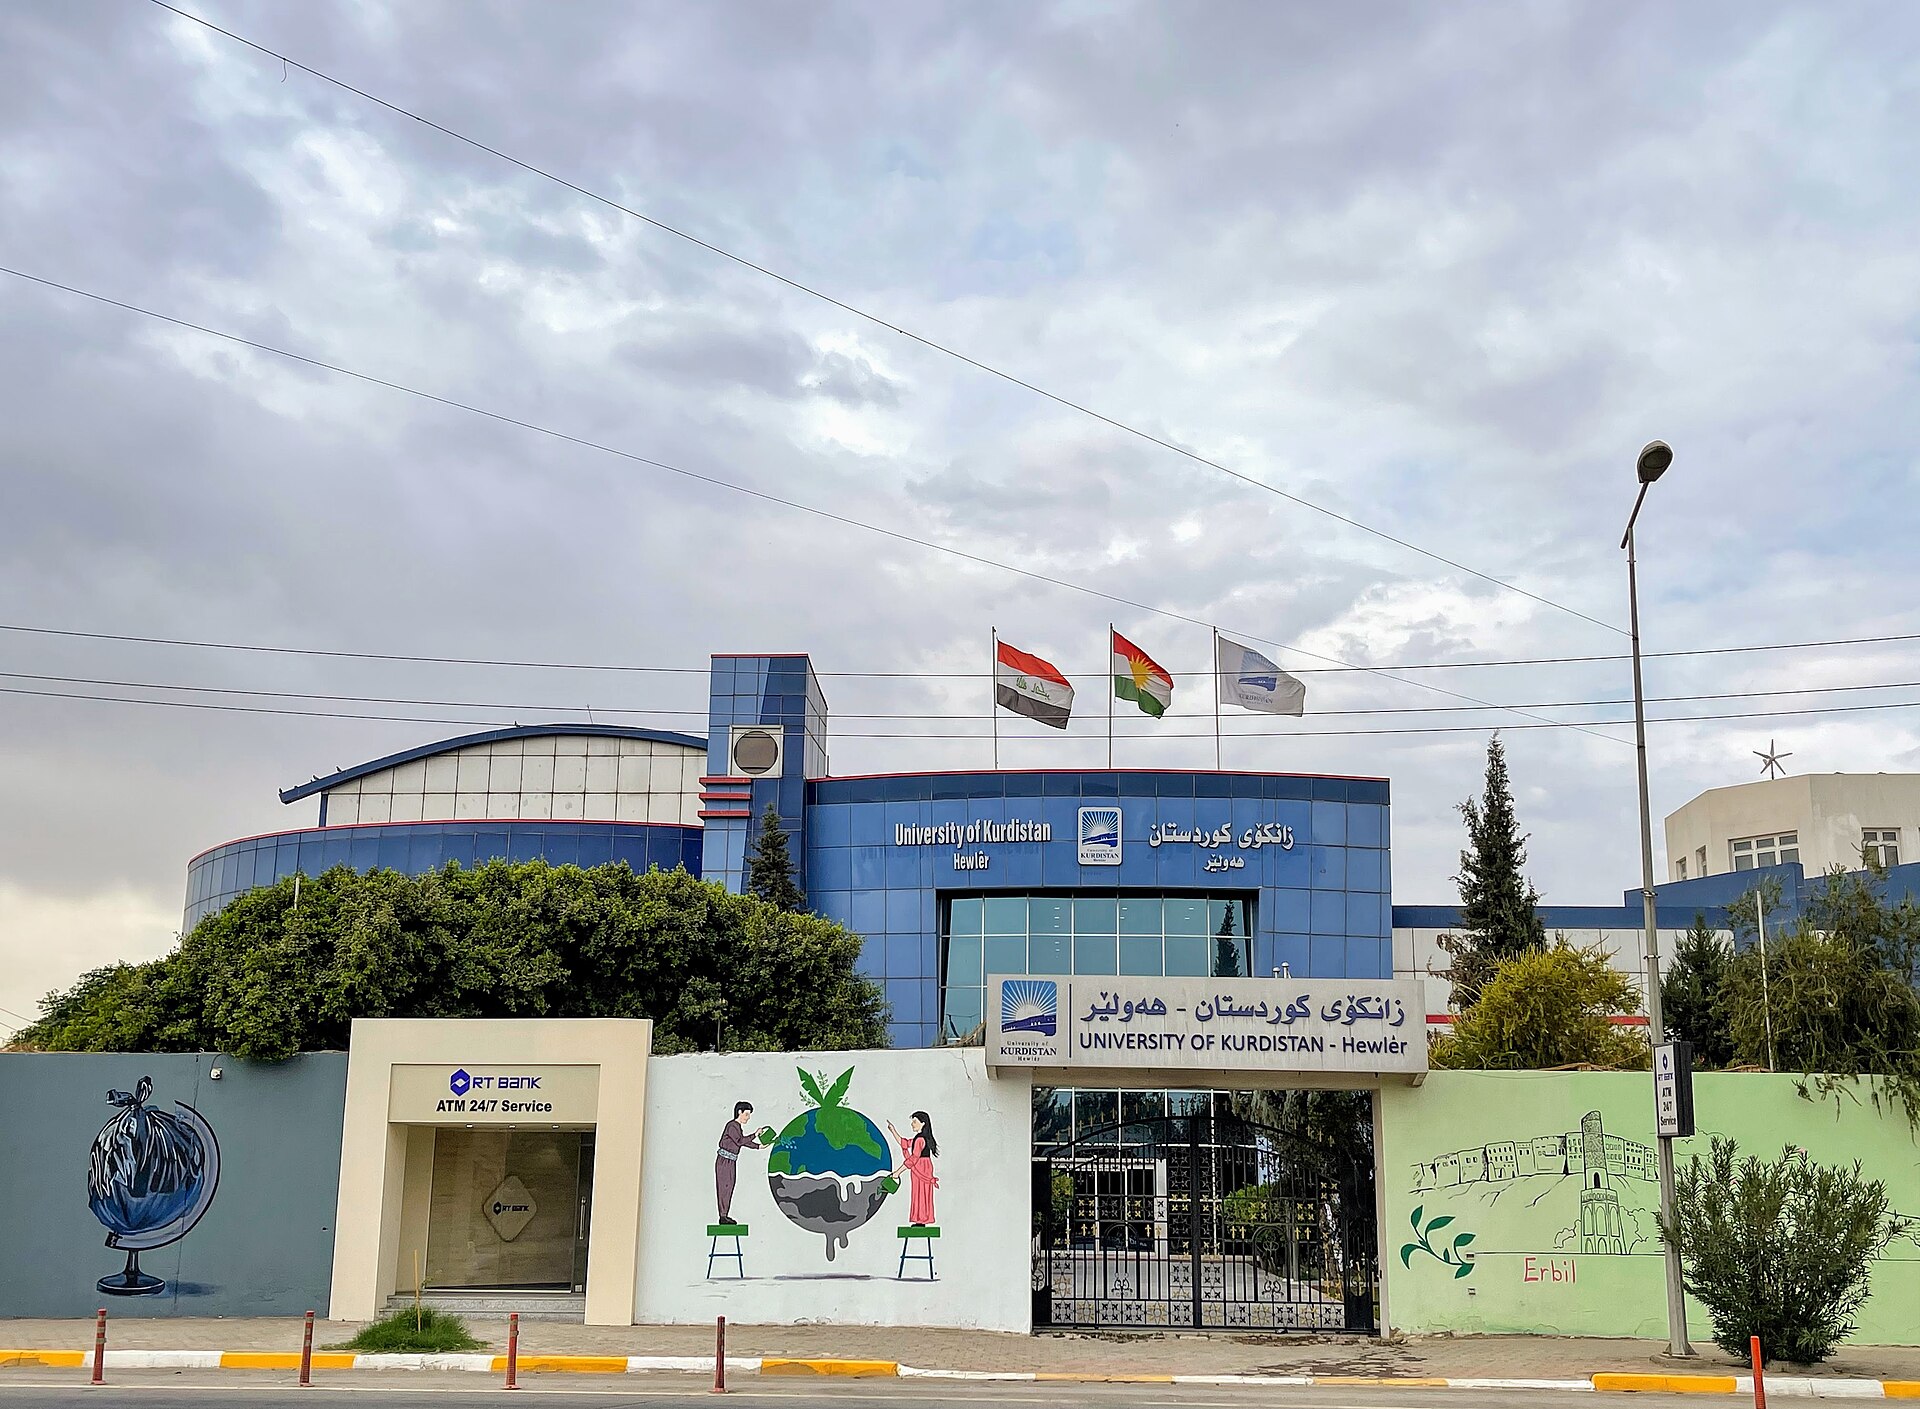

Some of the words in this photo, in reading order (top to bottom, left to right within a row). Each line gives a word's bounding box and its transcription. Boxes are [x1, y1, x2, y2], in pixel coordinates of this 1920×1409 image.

[895, 821, 964, 849] University
[967, 818, 981, 843] of
[983, 818, 1051, 842] Kurdistan
[953, 850, 990, 869] Hewlêr
[1080, 1032, 1185, 1050] UNIVERSITY
[1190, 1034, 1215, 1050] OF
[1221, 1034, 1324, 1053] KURDISTAN
[1000, 1047, 1057, 1056] KURDISTAN
[472, 1077, 494, 1089] RT
[1662, 1087, 1671, 1097] ATM
[436, 1099, 466, 1112] ATM
[469, 1099, 498, 1112] 24/7
[501, 1099, 552, 1112] Service
[1660, 1116, 1676, 1126] Service
[1524, 1257, 1576, 1284] Erbil
